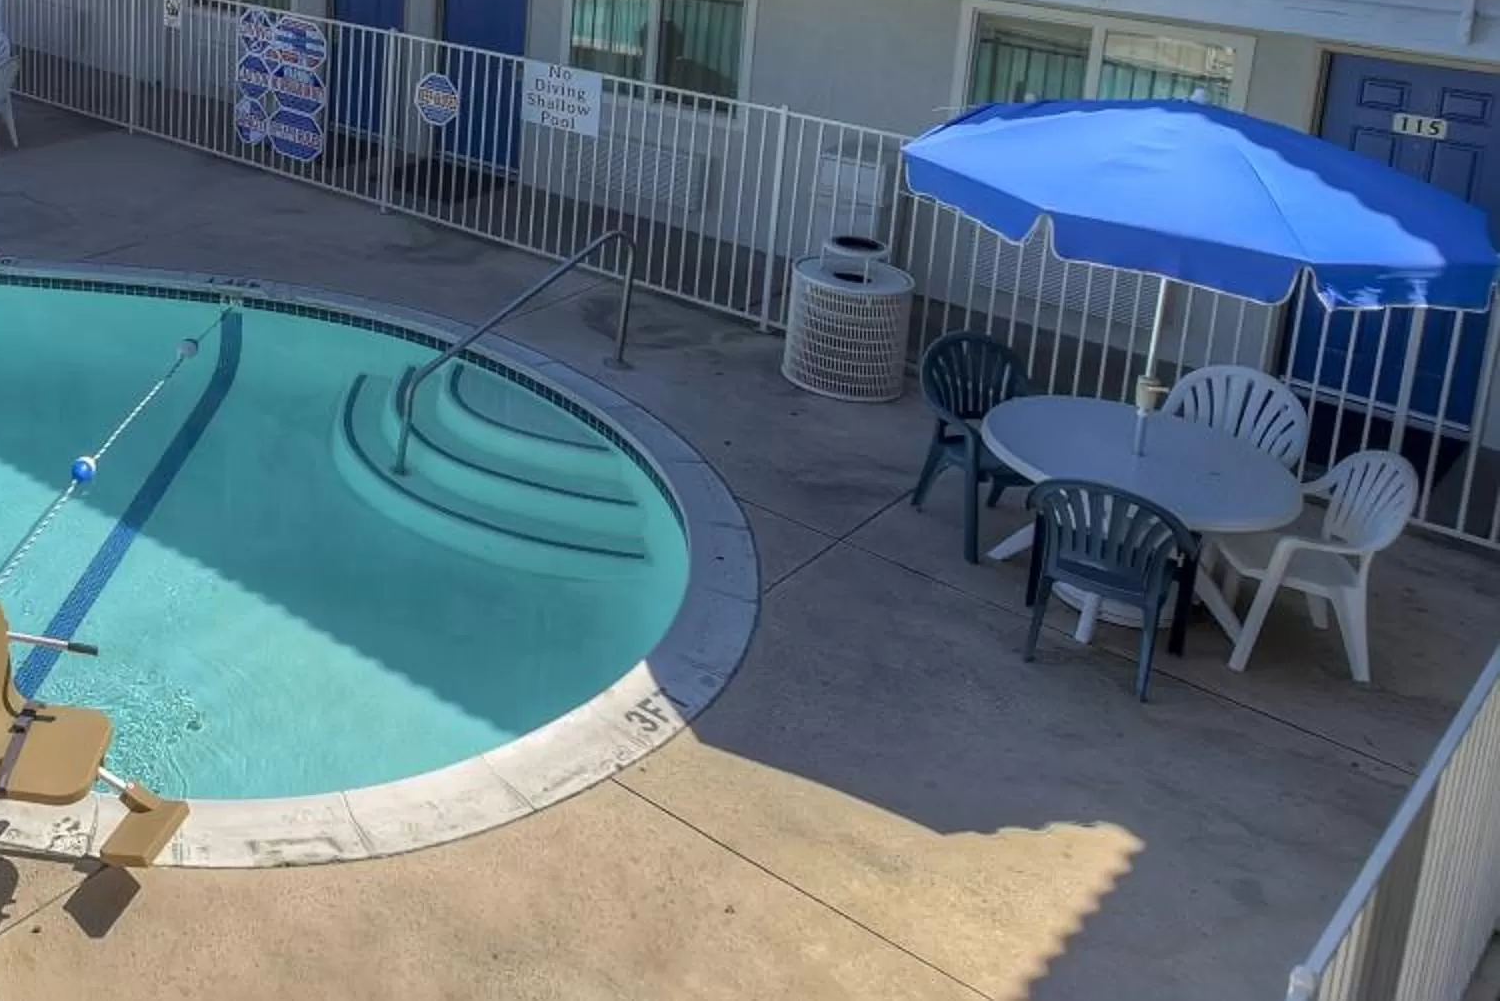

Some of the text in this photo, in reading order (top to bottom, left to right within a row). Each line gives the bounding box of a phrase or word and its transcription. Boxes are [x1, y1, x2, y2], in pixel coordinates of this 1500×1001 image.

[548, 65, 572, 80] No
[535, 78, 586, 103] Diving
[526, 92, 591, 116] Shallow
[541, 110, 575, 130] Pool
[1400, 116, 1442, 136] 115
